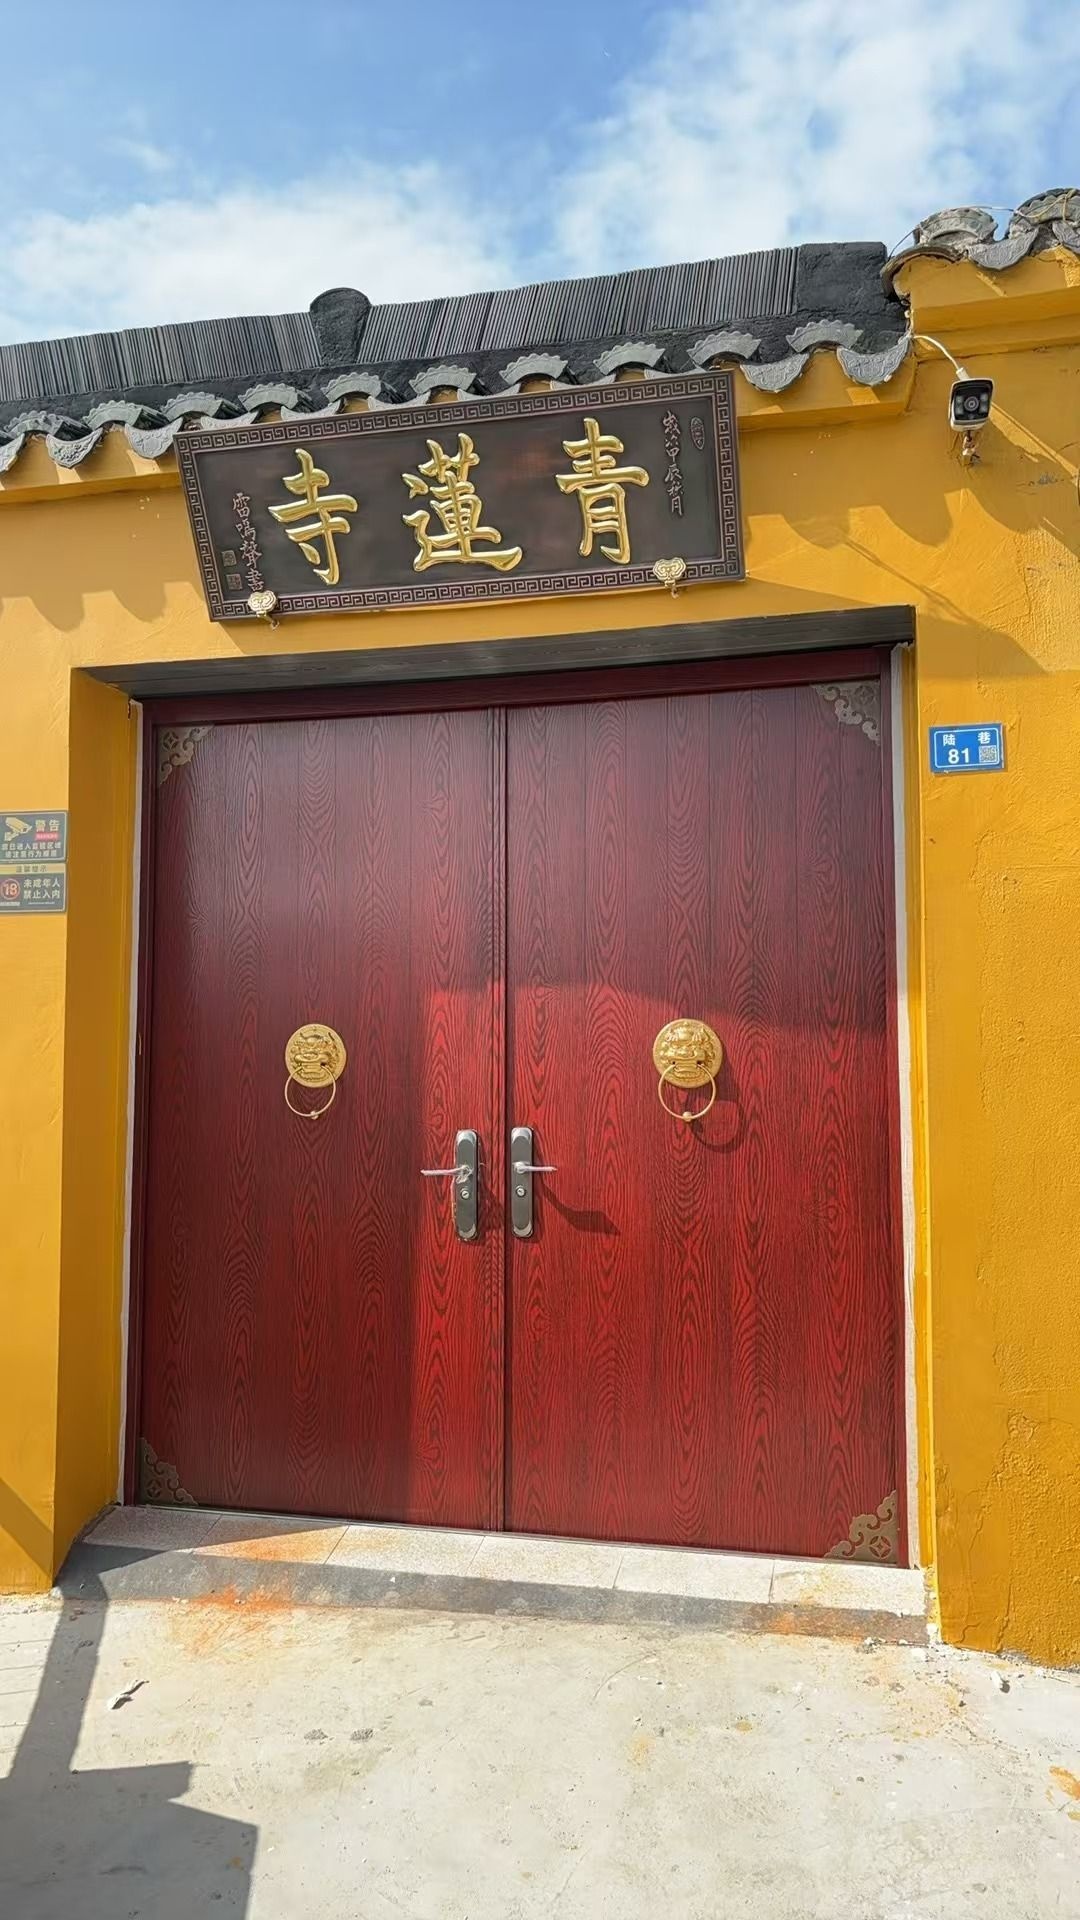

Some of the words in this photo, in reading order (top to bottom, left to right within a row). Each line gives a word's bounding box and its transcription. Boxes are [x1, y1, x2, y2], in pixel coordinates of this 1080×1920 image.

[267, 416, 650, 586] 青蓮寺
[942, 731, 991, 747] 陆巷
[948, 747, 970, 765] 81
[35, 819, 60, 833] 警告
[3, 882, 18, 896] 18
[23, 877, 61, 889] 未成年人
[23, 889, 61, 900] 禁止入内
